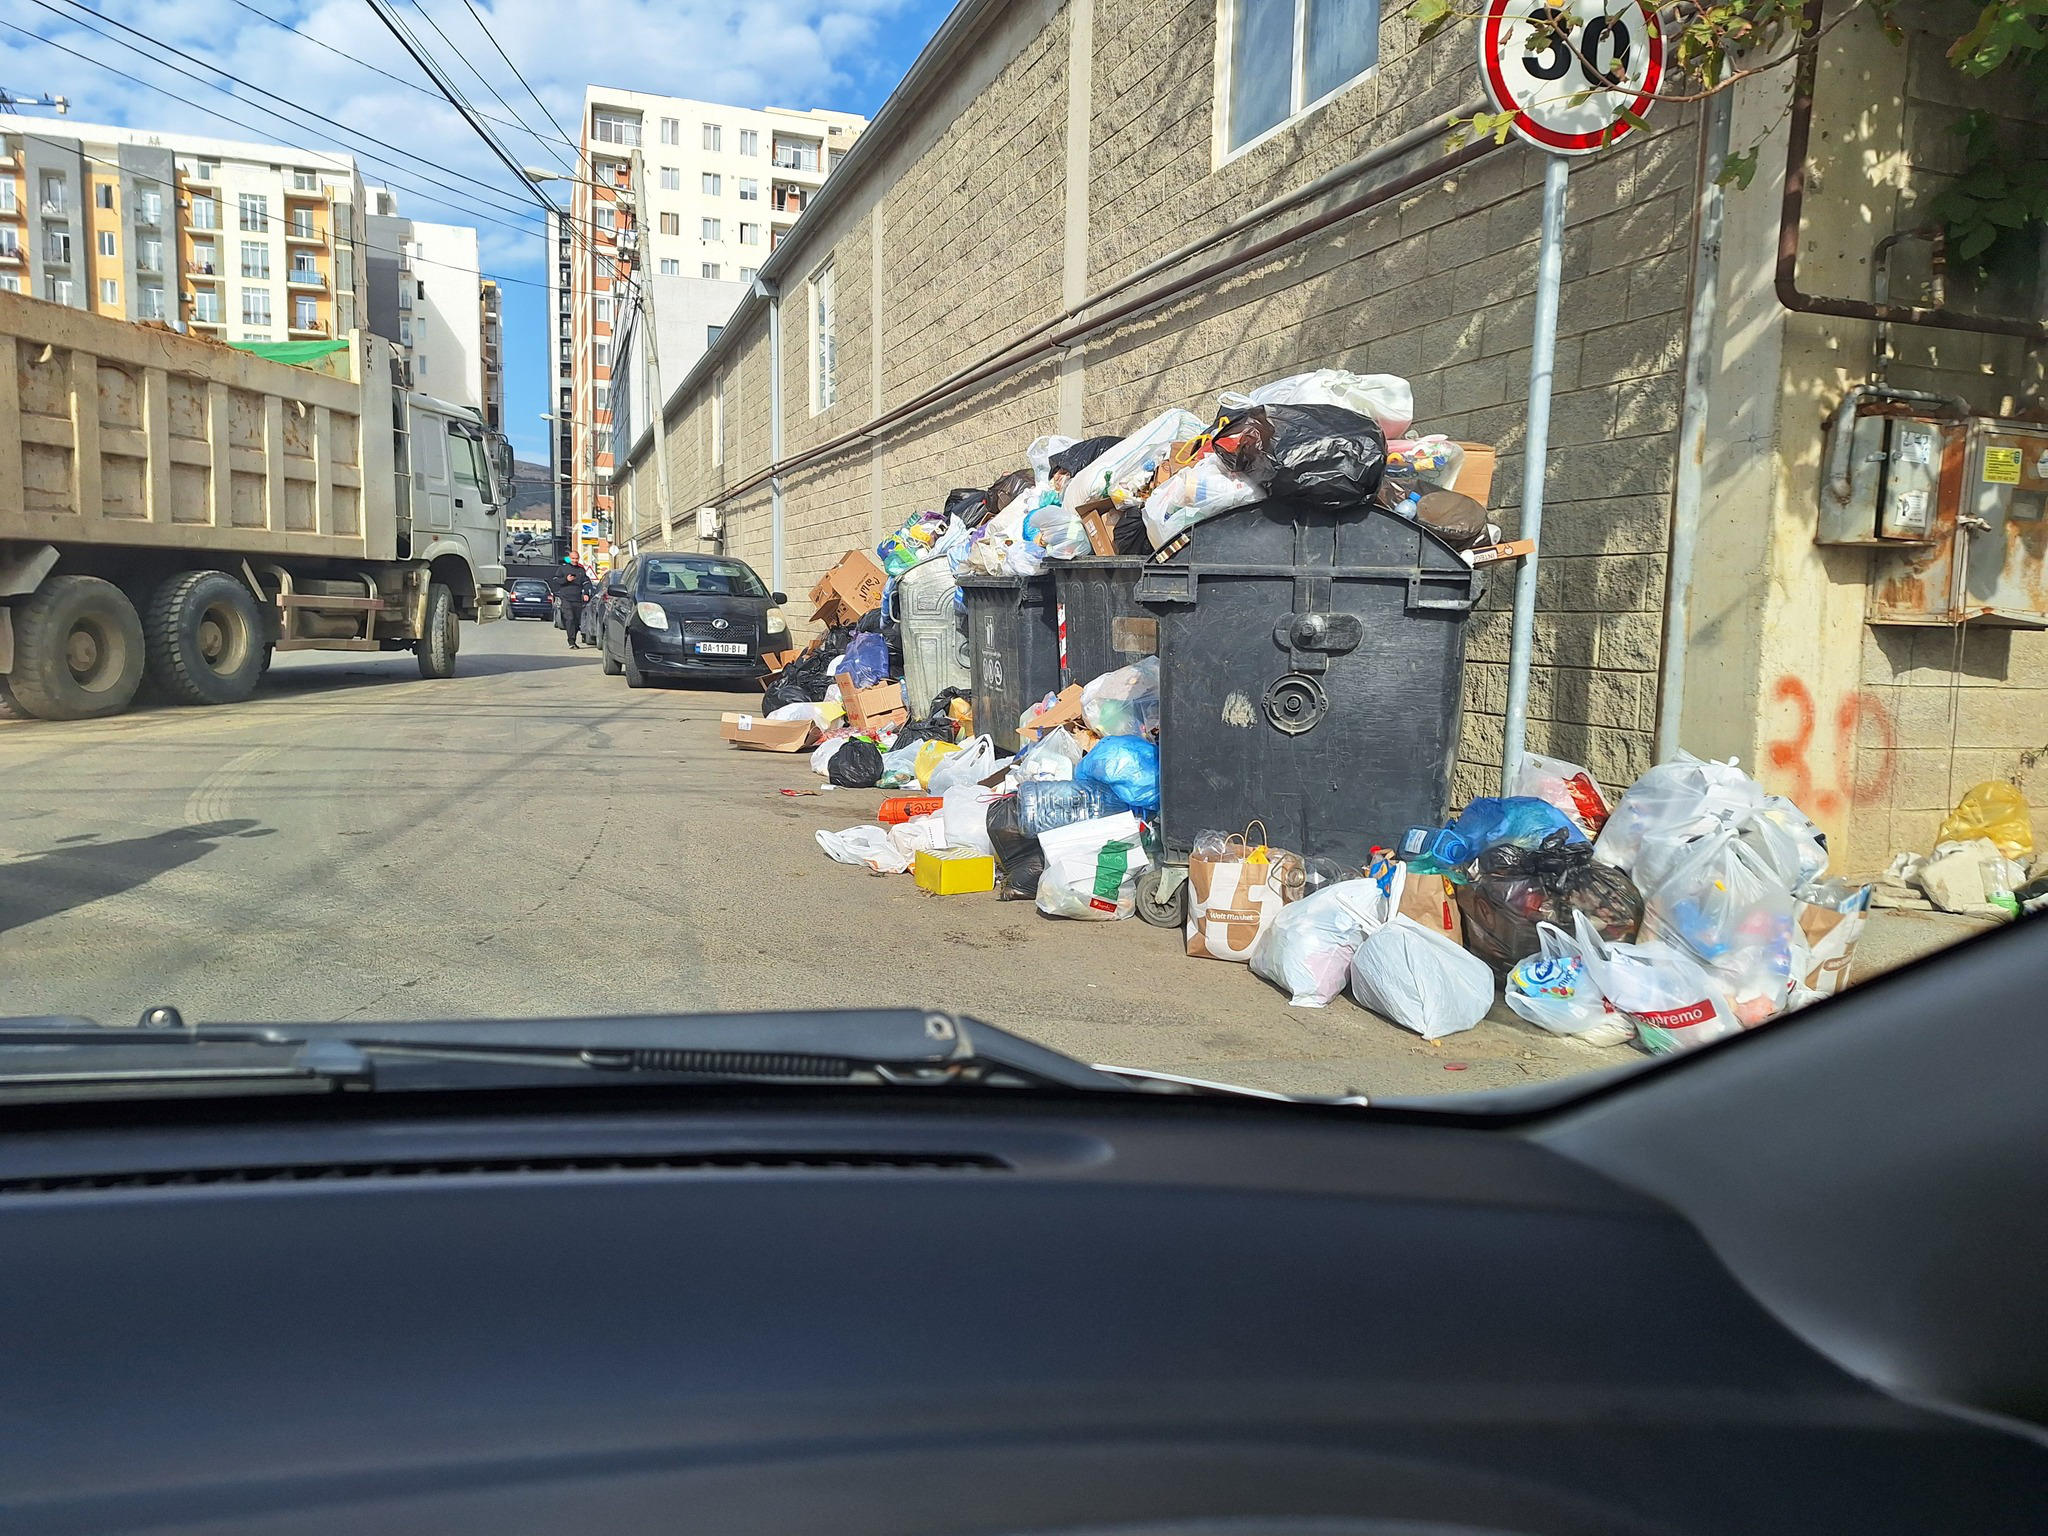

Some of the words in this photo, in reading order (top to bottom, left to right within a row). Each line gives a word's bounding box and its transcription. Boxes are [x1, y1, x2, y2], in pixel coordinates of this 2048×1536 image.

[1522, 7, 1630, 87] 30
[702, 644, 740, 653] BA-110-BI
[1210, 912, 1226, 920] Wolt
[1227, 913, 1254, 921] Market
